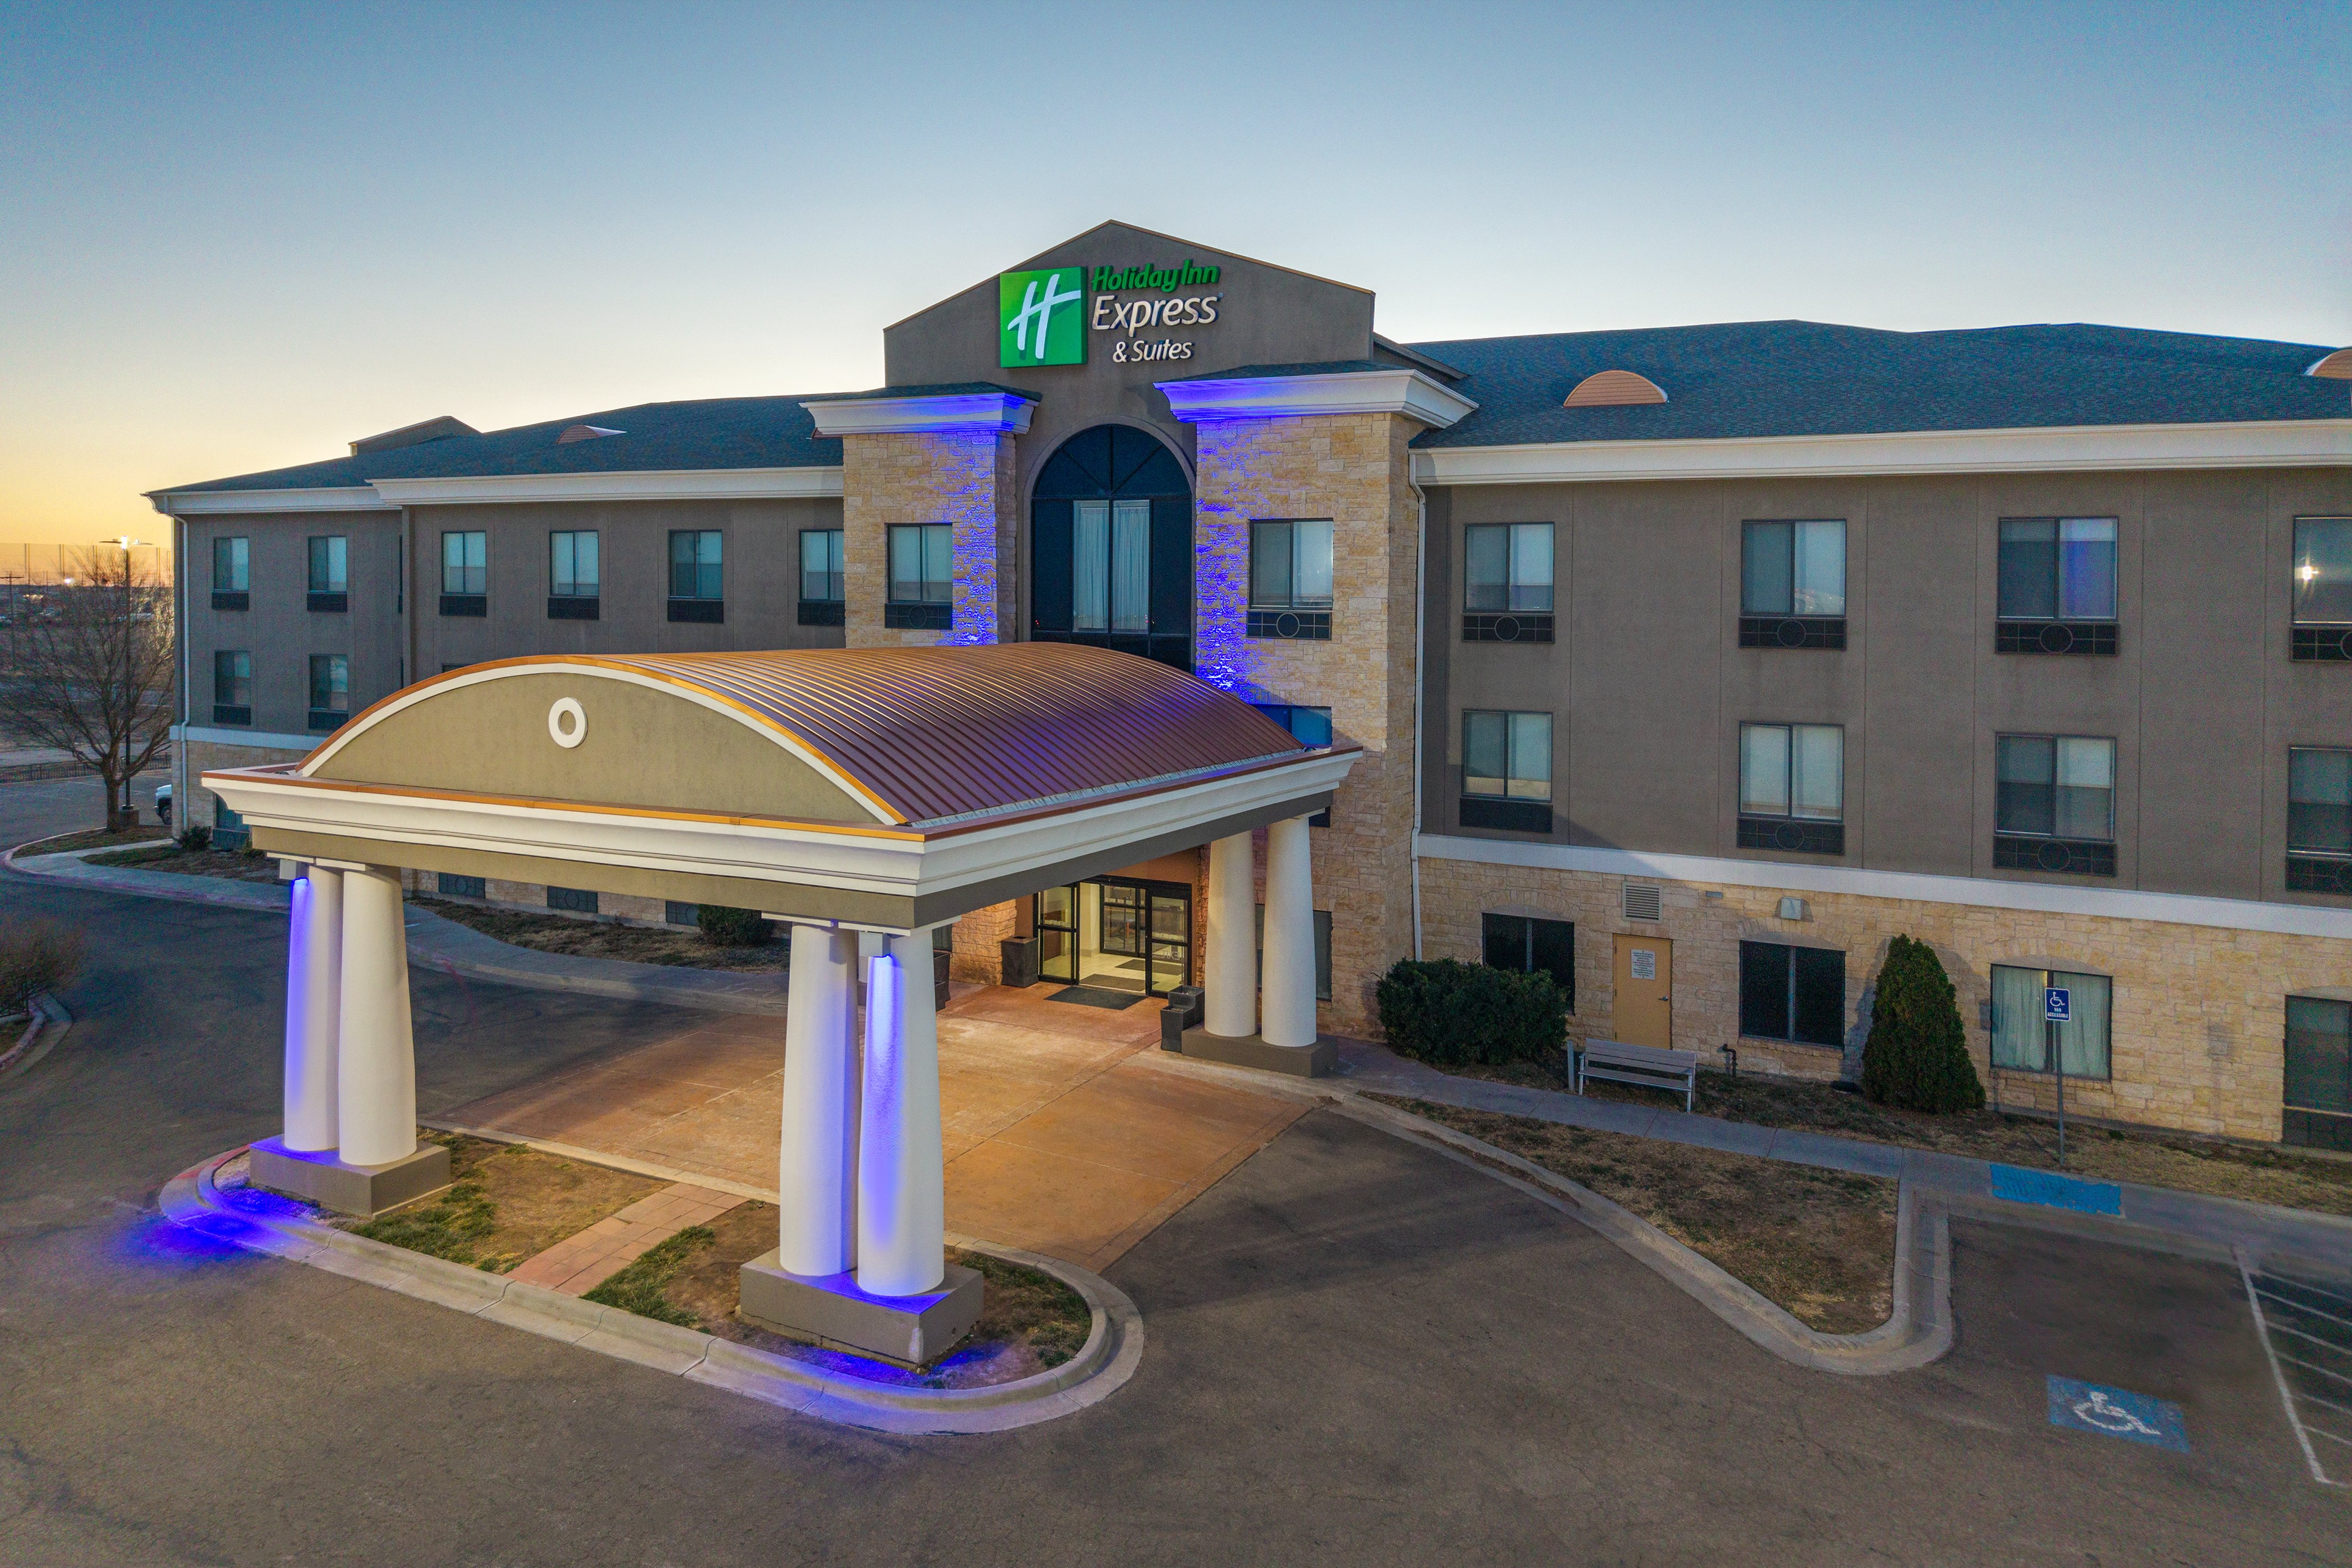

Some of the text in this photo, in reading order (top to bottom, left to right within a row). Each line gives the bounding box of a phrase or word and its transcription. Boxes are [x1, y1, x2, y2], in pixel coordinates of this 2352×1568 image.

[1091, 258, 1221, 293] Holiday Inn
[1092, 294, 1218, 338] Express
[1112, 338, 1193, 363] & Suites
